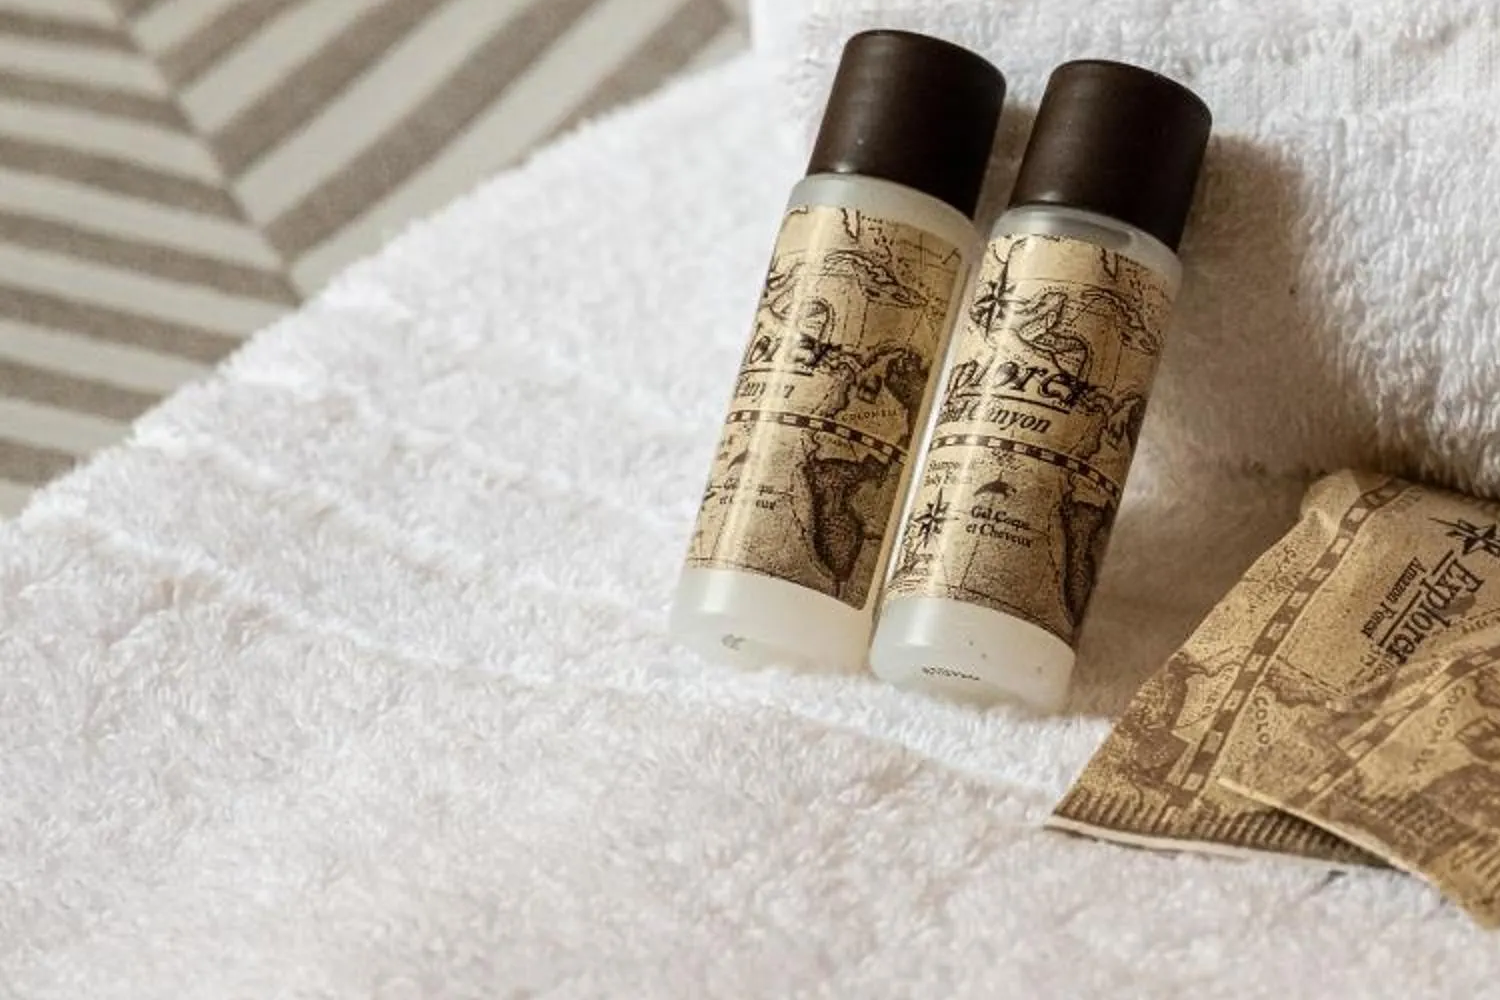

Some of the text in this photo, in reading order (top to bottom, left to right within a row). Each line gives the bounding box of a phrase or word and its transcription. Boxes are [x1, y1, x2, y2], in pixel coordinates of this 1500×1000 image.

[1386, 557, 1427, 604] Amazon
[1361, 602, 1396, 639] Forest
[1387, 558, 1486, 665] Explorer
